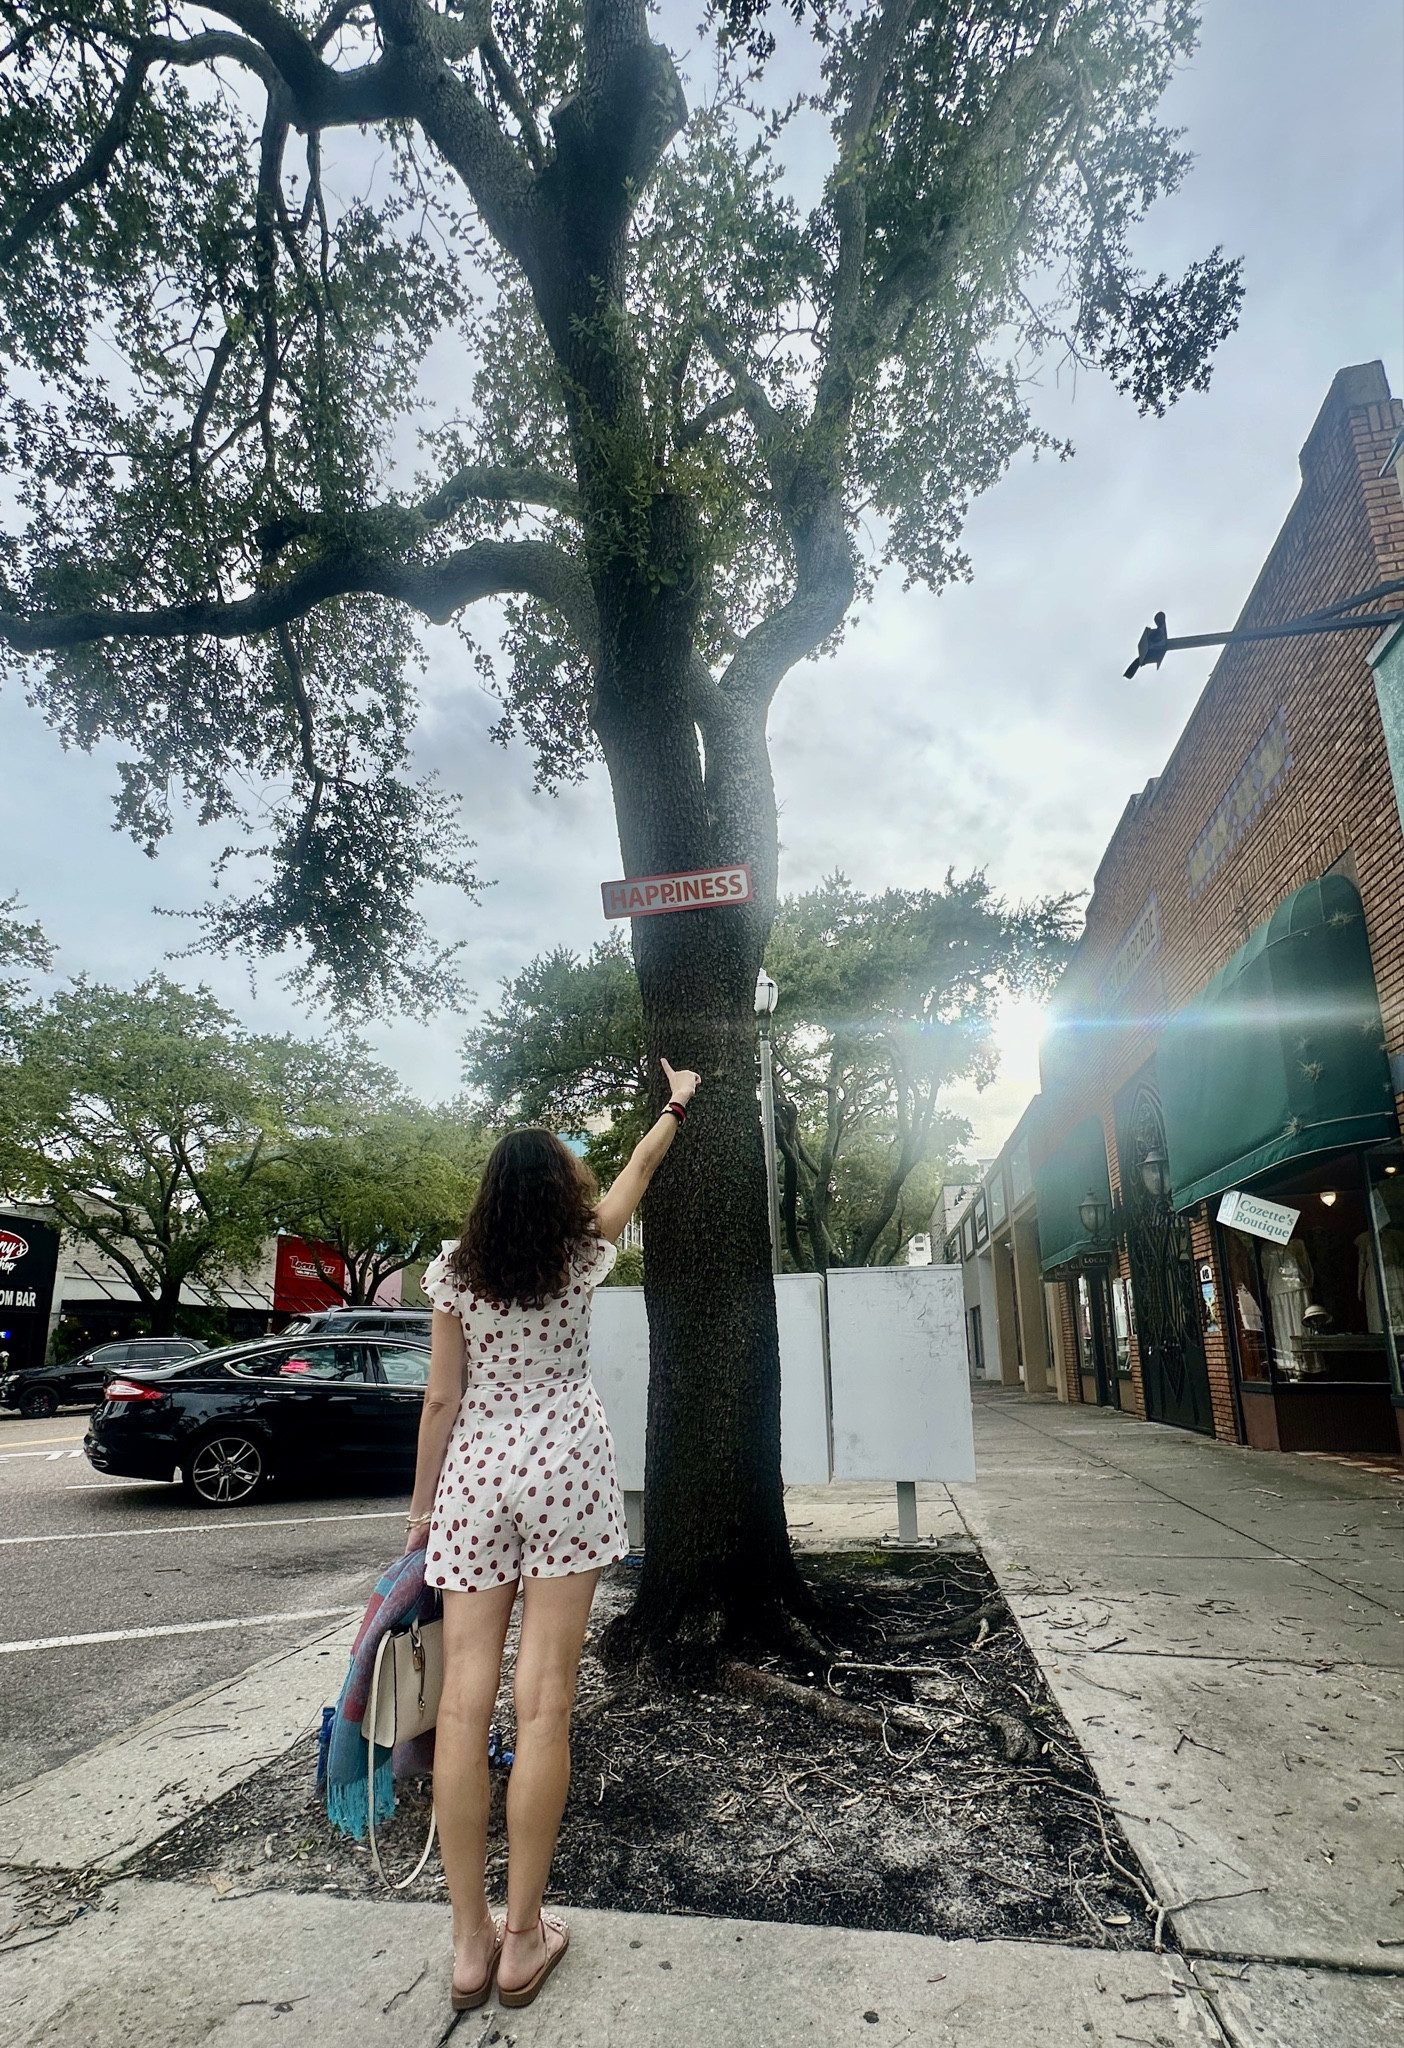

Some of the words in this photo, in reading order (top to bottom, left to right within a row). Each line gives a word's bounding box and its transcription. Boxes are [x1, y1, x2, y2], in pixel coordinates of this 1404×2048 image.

[610, 874, 742, 910] HAPPINESS
[1126, 910, 1156, 972] ARCADE
[1234, 1211, 1290, 1238] Boutique
[1240, 1199, 1295, 1226] Cozette's
[1083, 1257, 1108, 1265] LOCAL
[16, 1291, 36, 1307] BAR
